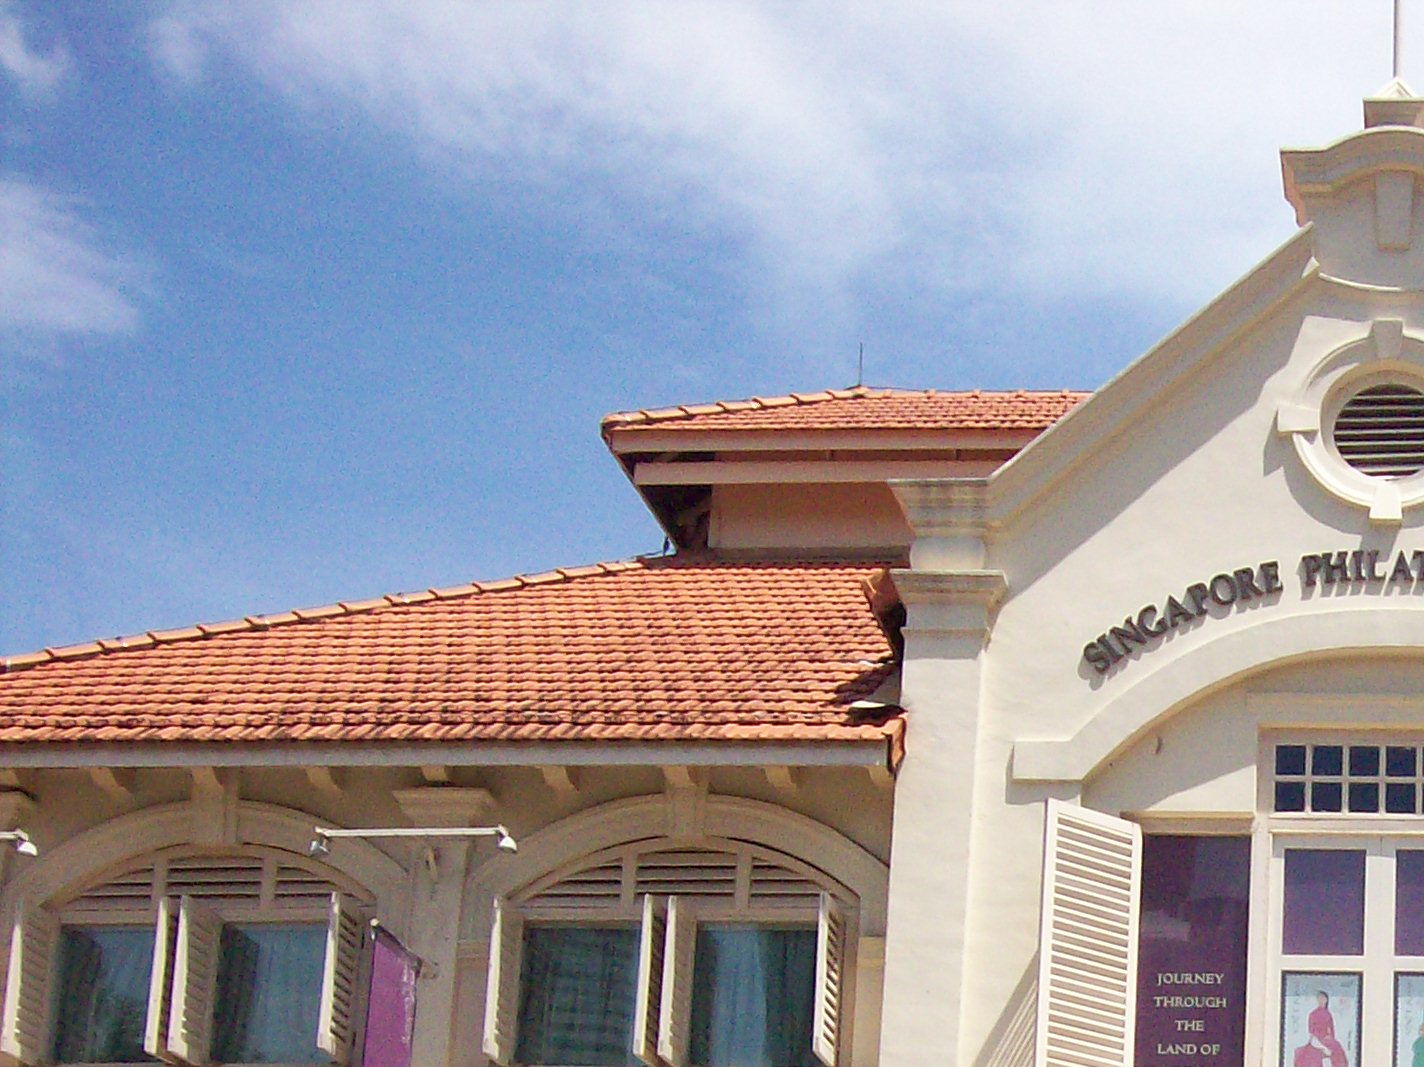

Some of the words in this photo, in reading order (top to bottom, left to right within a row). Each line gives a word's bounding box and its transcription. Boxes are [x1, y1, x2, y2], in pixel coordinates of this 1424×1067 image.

[1081, 560, 1284, 676] SINGAPORE
[1157, 973, 1224, 987] JOURNEY
[1153, 995, 1227, 1009] THROUGH
[1174, 1020, 1205, 1032] THE
[1157, 1043, 1198, 1056] LAND
[1199, 1044, 1221, 1056] OF
